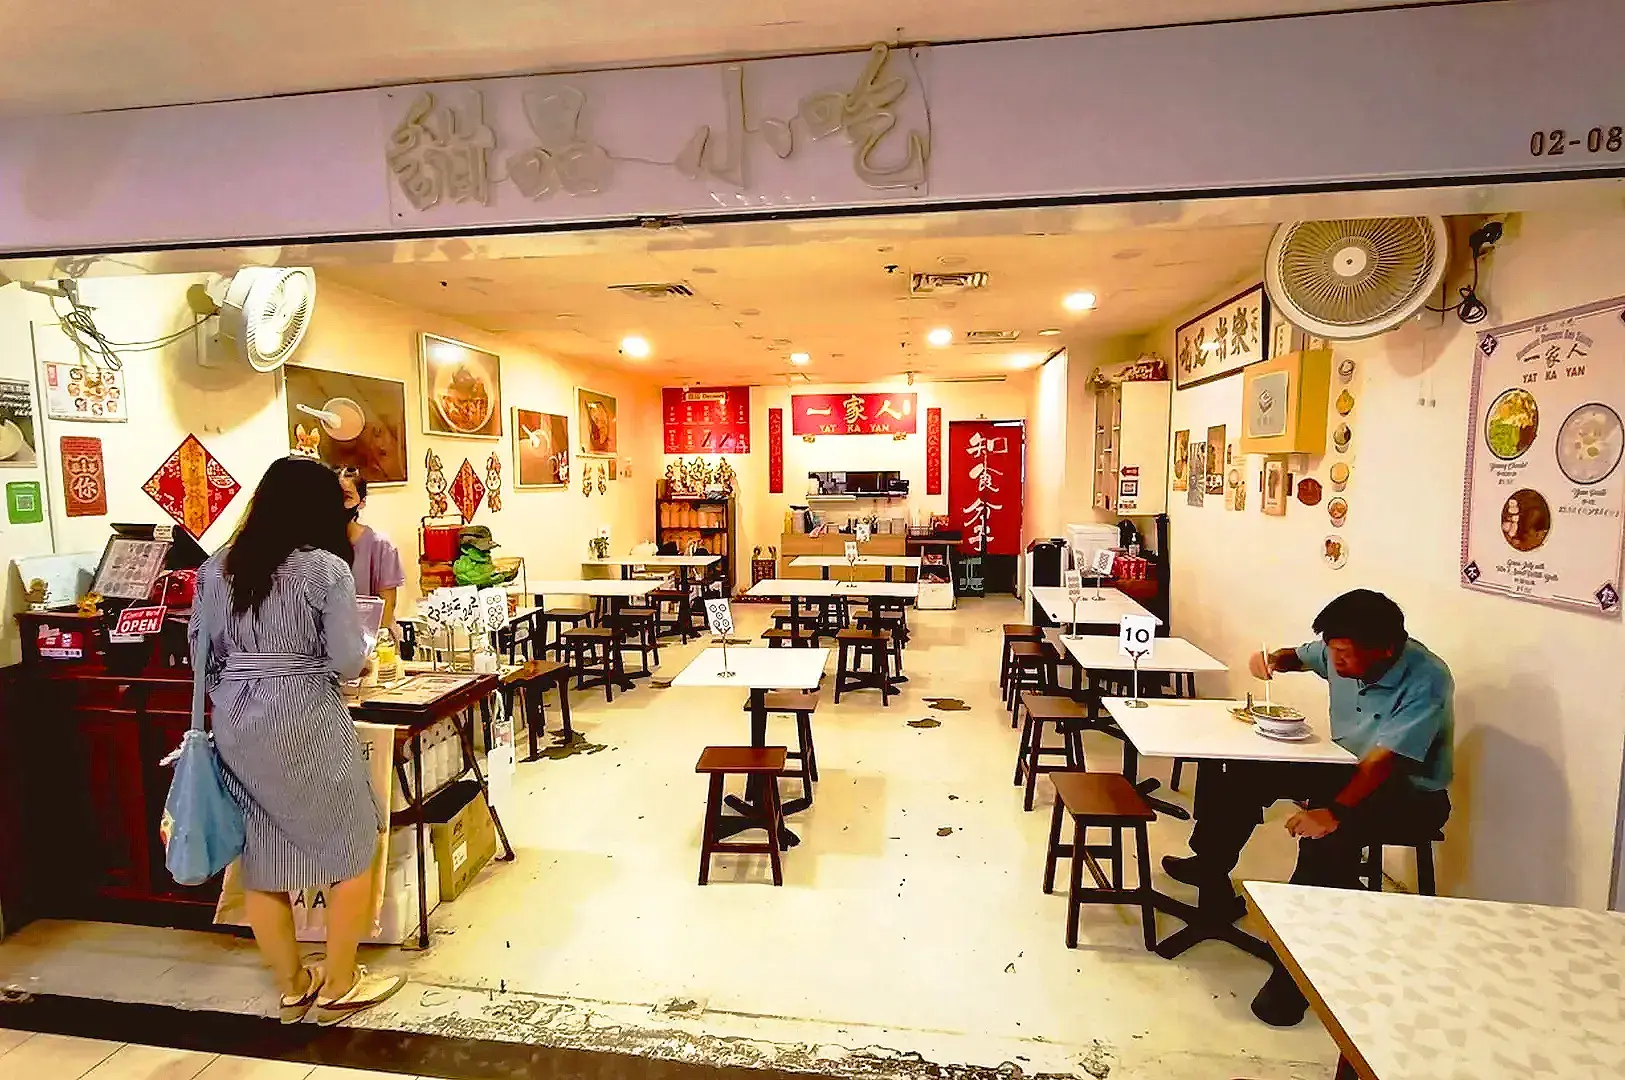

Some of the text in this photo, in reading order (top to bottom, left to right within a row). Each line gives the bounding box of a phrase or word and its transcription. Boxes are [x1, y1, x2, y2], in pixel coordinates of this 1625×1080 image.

[1530, 126, 1622, 156] 02-08
[1523, 343, 1588, 369] 一家人
[1523, 373, 1538, 384] YAT
[1566, 366, 1586, 377] YAN
[806, 394, 902, 424] 一家人
[819, 424, 837, 433] YAT
[870, 423, 889, 432] YAN
[121, 618, 158, 633] OPEN
[1125, 627, 1149, 643] 10
